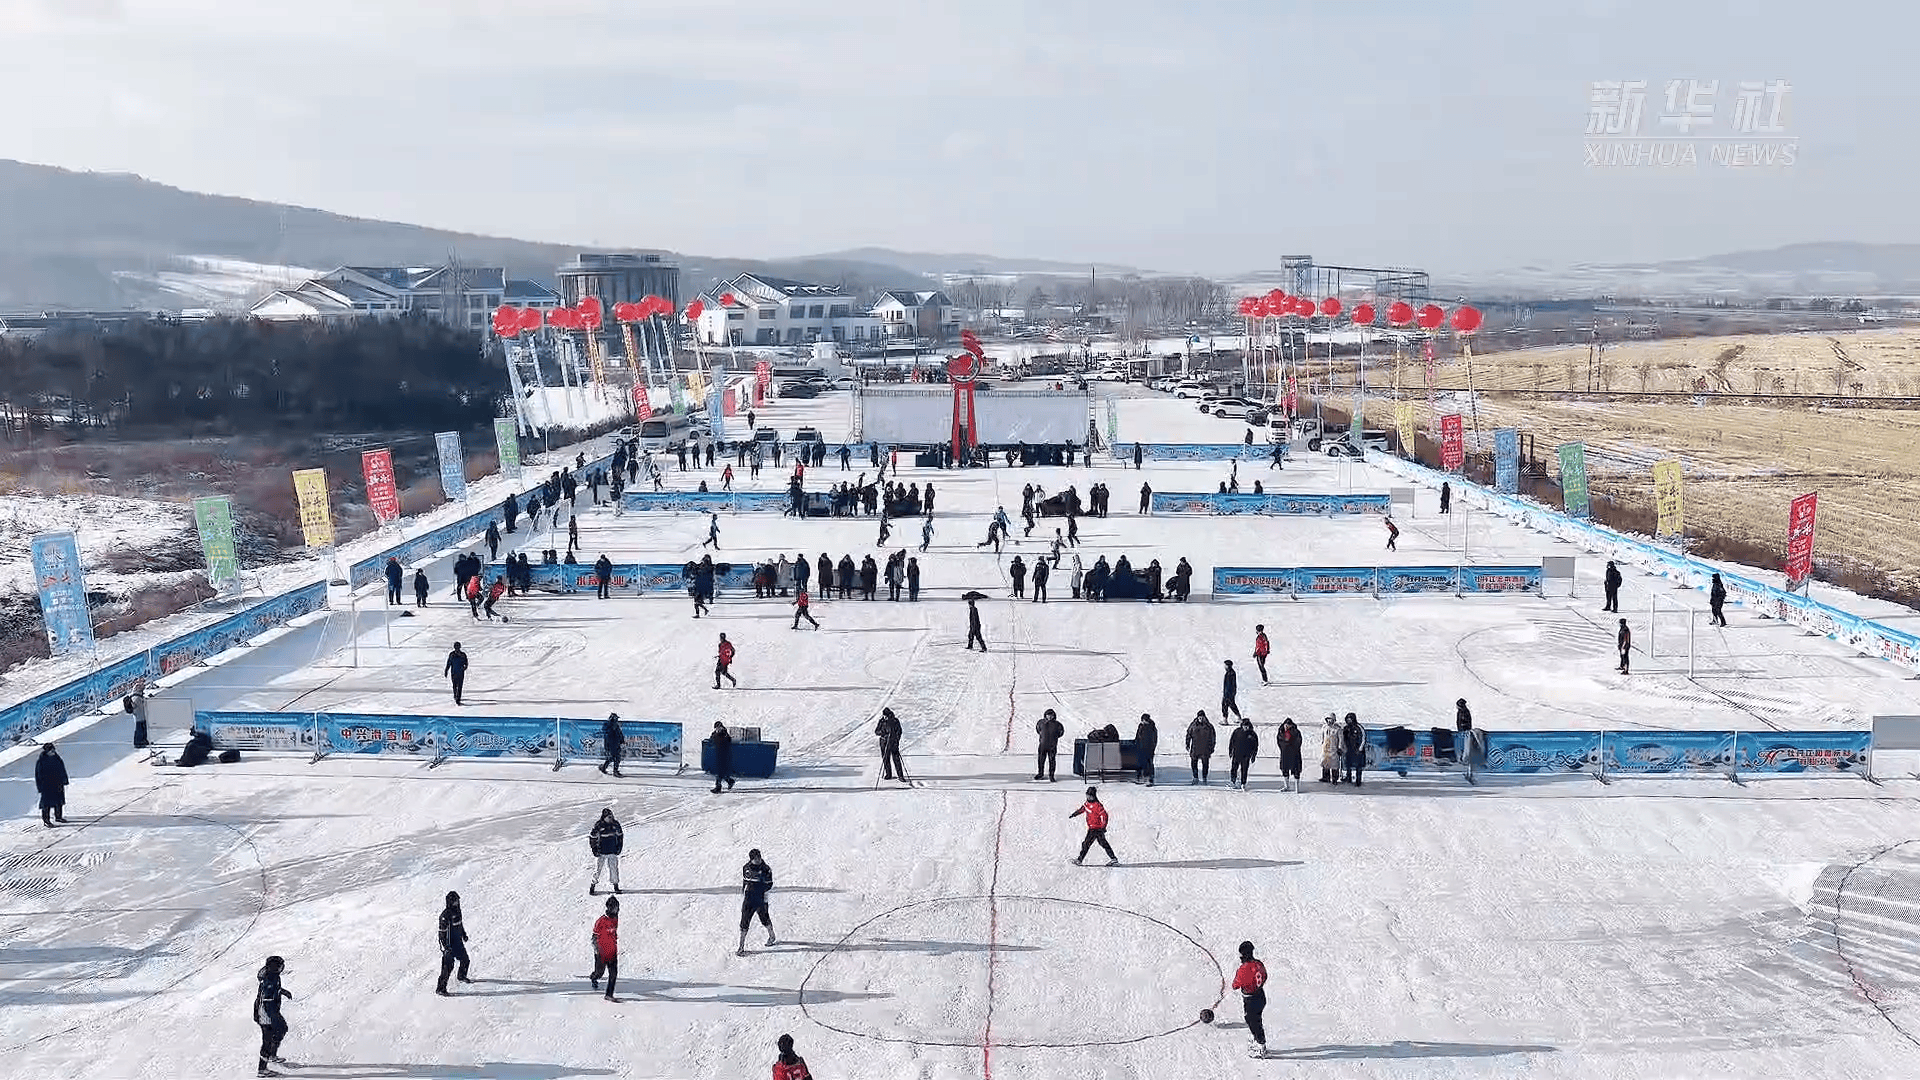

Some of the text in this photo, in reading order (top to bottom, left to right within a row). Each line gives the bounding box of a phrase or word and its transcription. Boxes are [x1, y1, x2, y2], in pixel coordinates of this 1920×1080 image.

[341, 728, 414, 742] 中兴滑雪场
